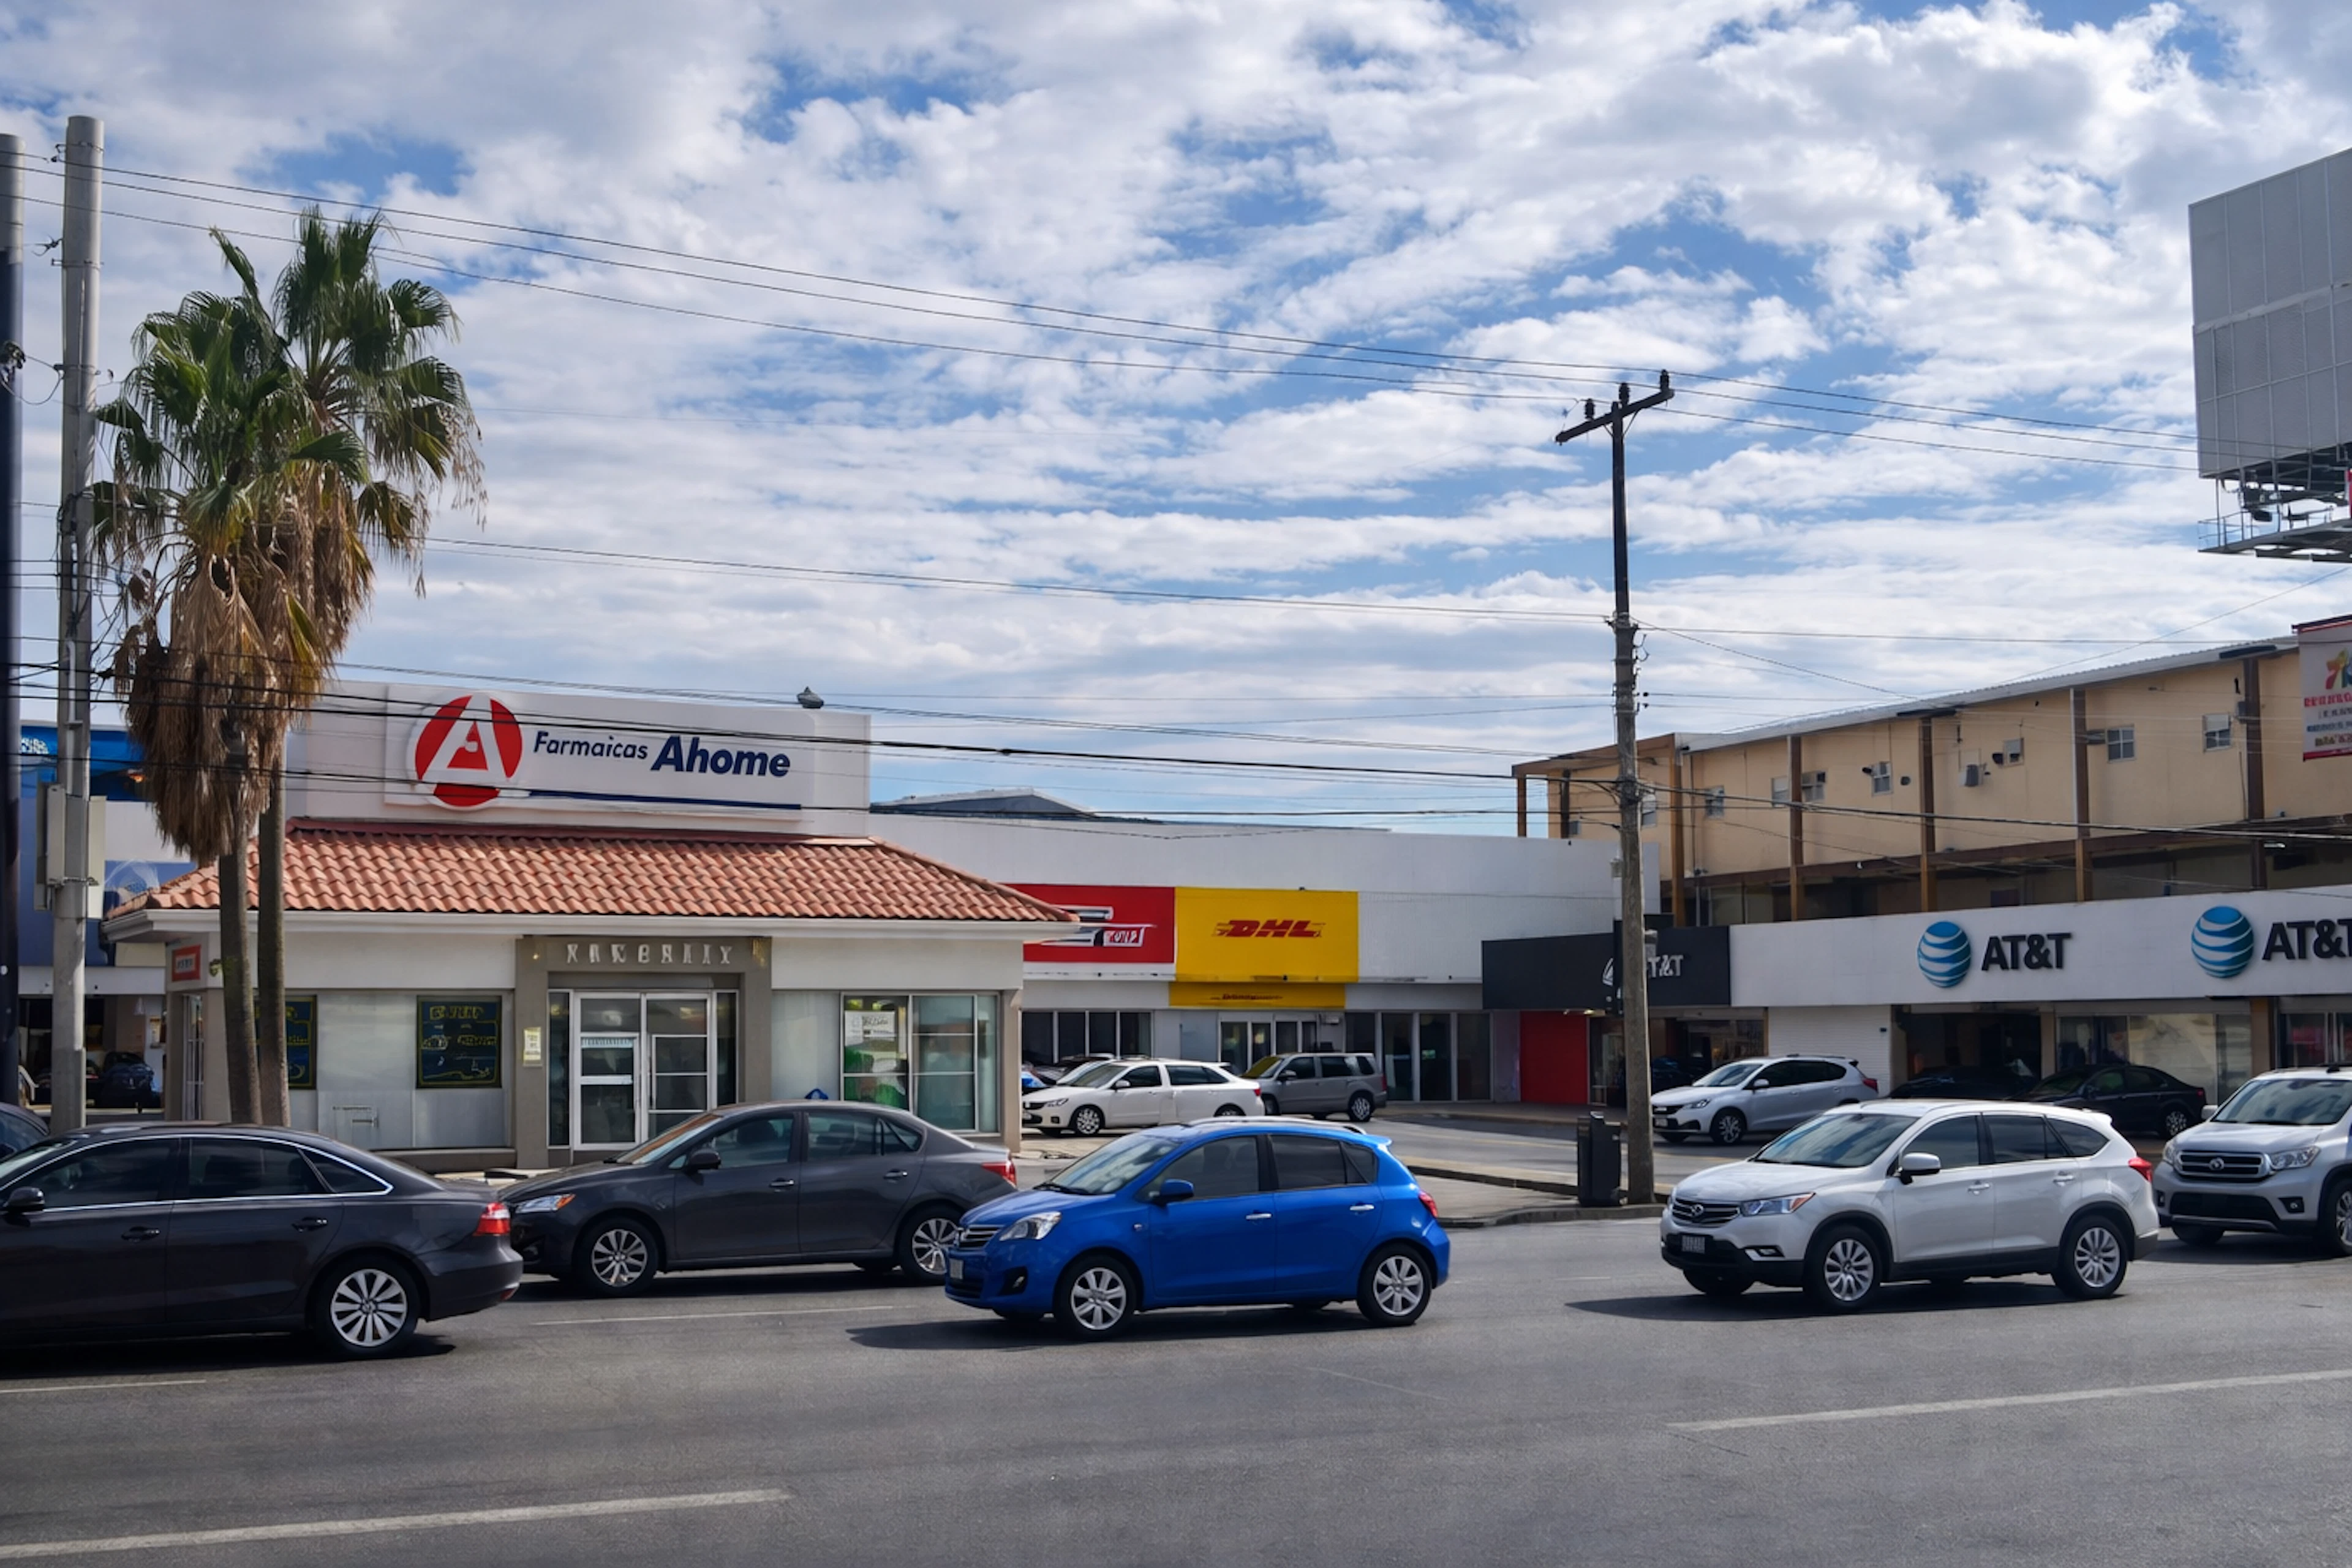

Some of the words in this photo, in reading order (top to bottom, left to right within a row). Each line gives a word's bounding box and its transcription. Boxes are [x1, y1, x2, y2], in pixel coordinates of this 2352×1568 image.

[533, 731, 648, 760] Farmaicas
[650, 735, 790, 777] Ahome
[1224, 919, 1319, 938] DHL
[1981, 933, 2071, 970] AT&T
